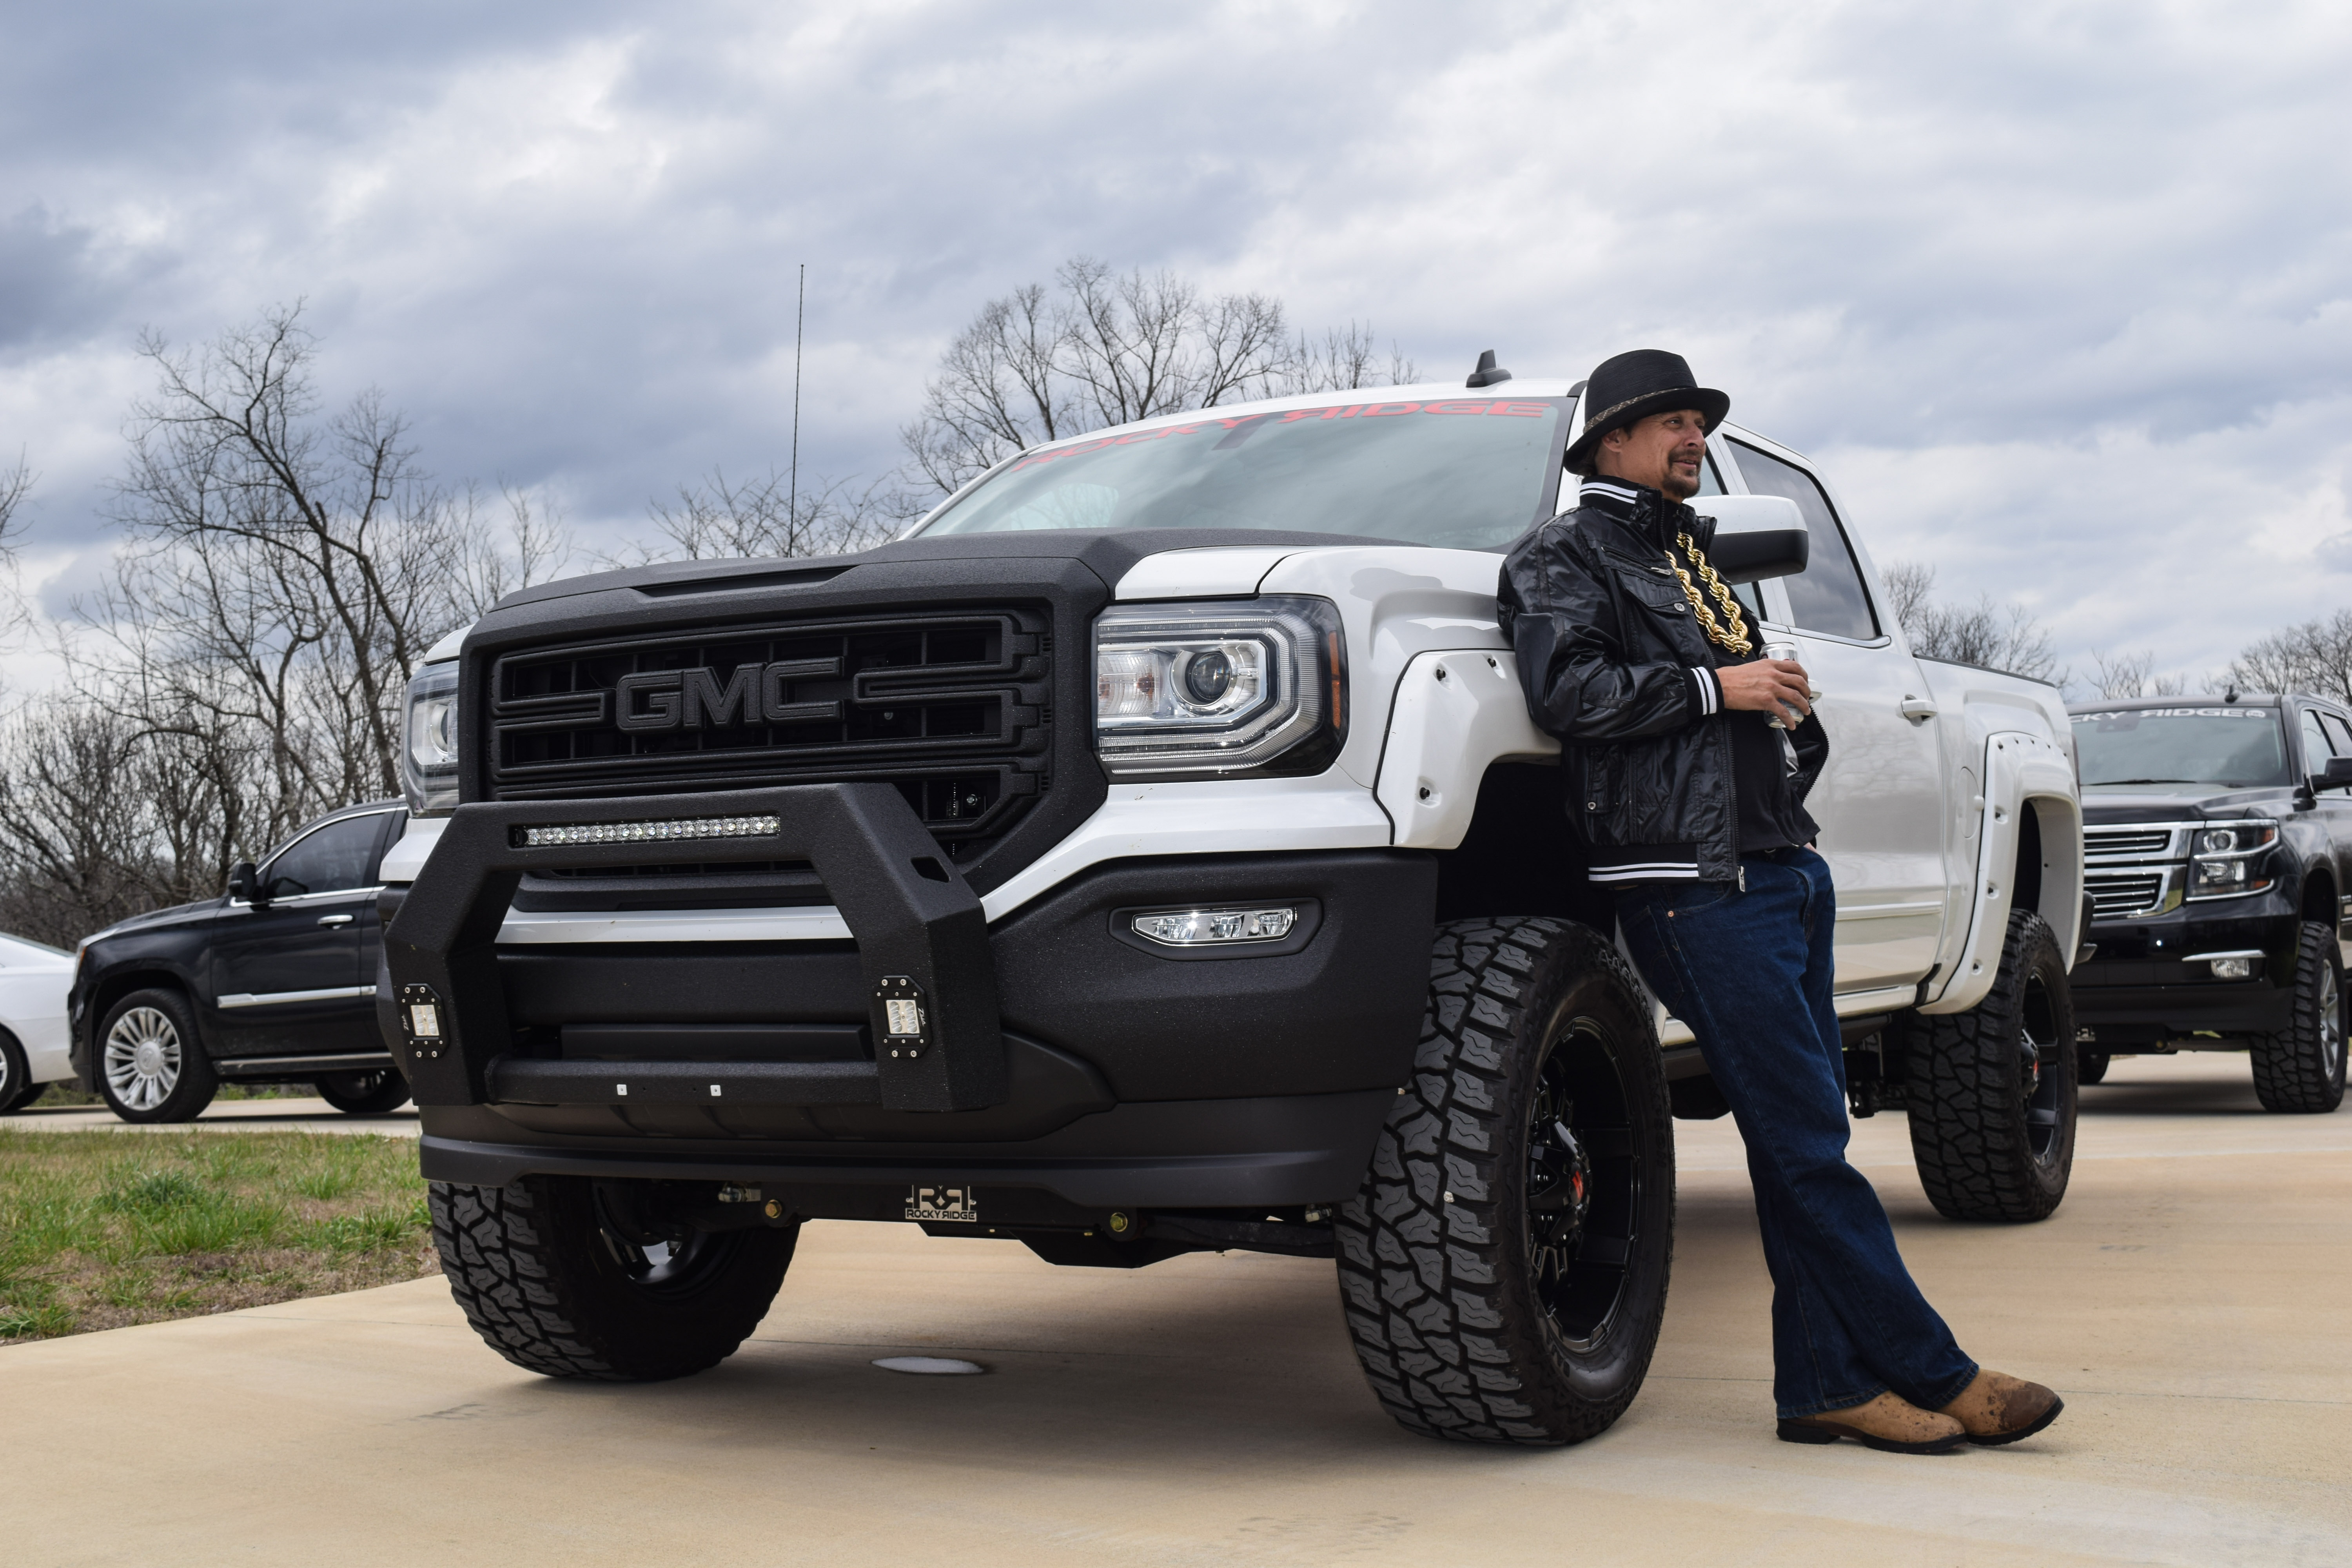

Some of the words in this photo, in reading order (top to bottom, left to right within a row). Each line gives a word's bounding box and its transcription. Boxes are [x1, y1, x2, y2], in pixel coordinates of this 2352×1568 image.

[1011, 414, 1268, 472] ROCKY
[616, 657, 844, 732] GMC
[907, 1209, 940, 1218] ROCKY
